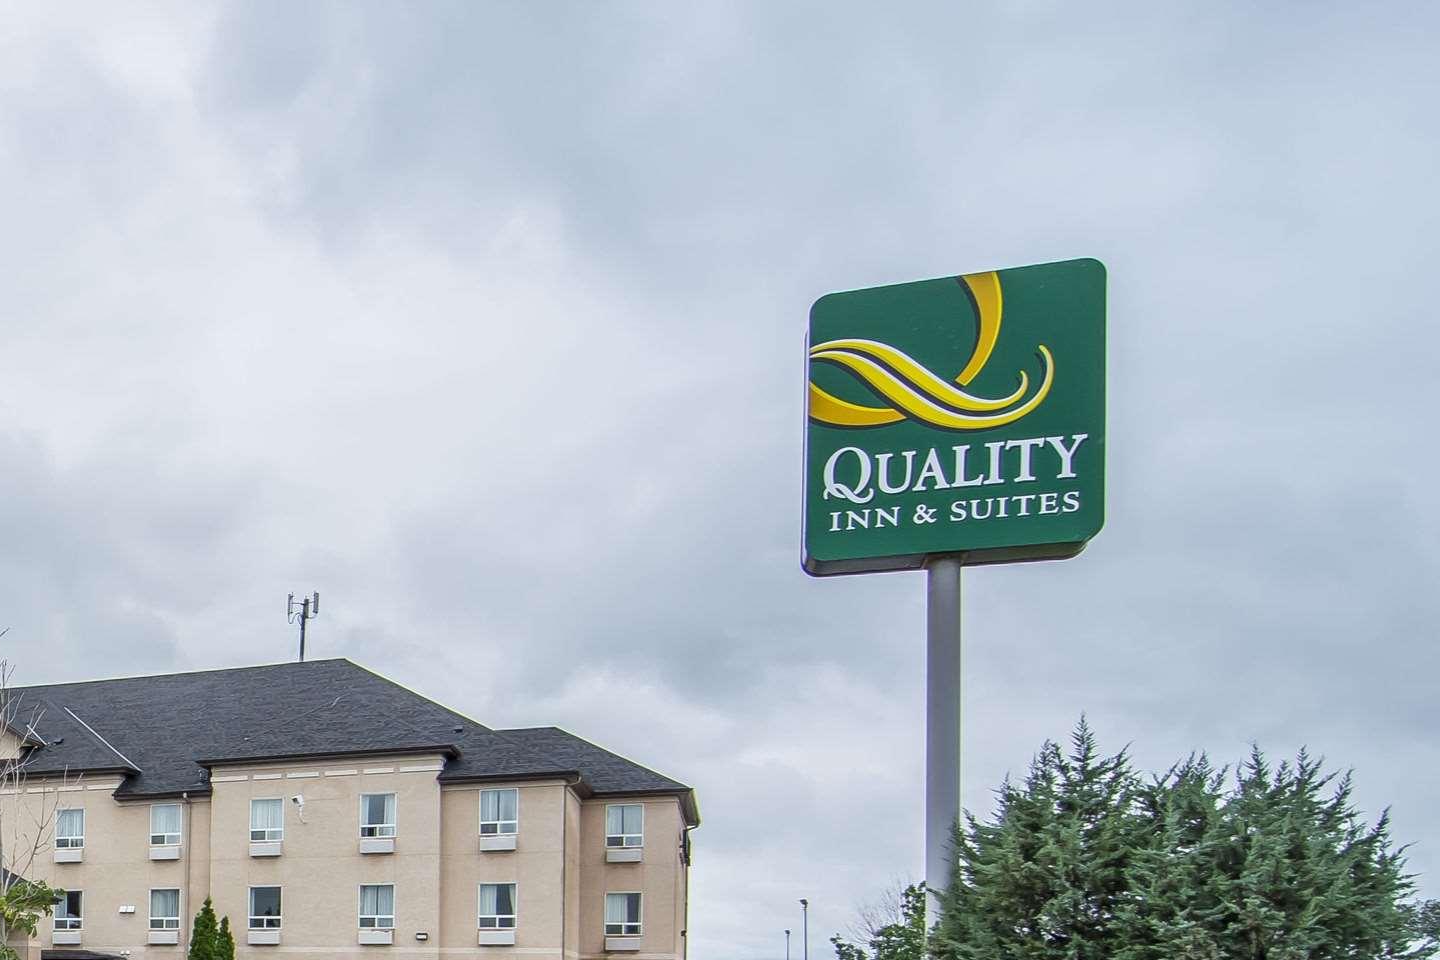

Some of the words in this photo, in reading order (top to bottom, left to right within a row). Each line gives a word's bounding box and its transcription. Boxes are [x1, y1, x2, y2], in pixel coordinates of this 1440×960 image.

[823, 433, 1088, 504] QUALITY
[828, 506, 900, 532] INN
[912, 503, 937, 524] &
[949, 491, 1080, 521] SUITES
